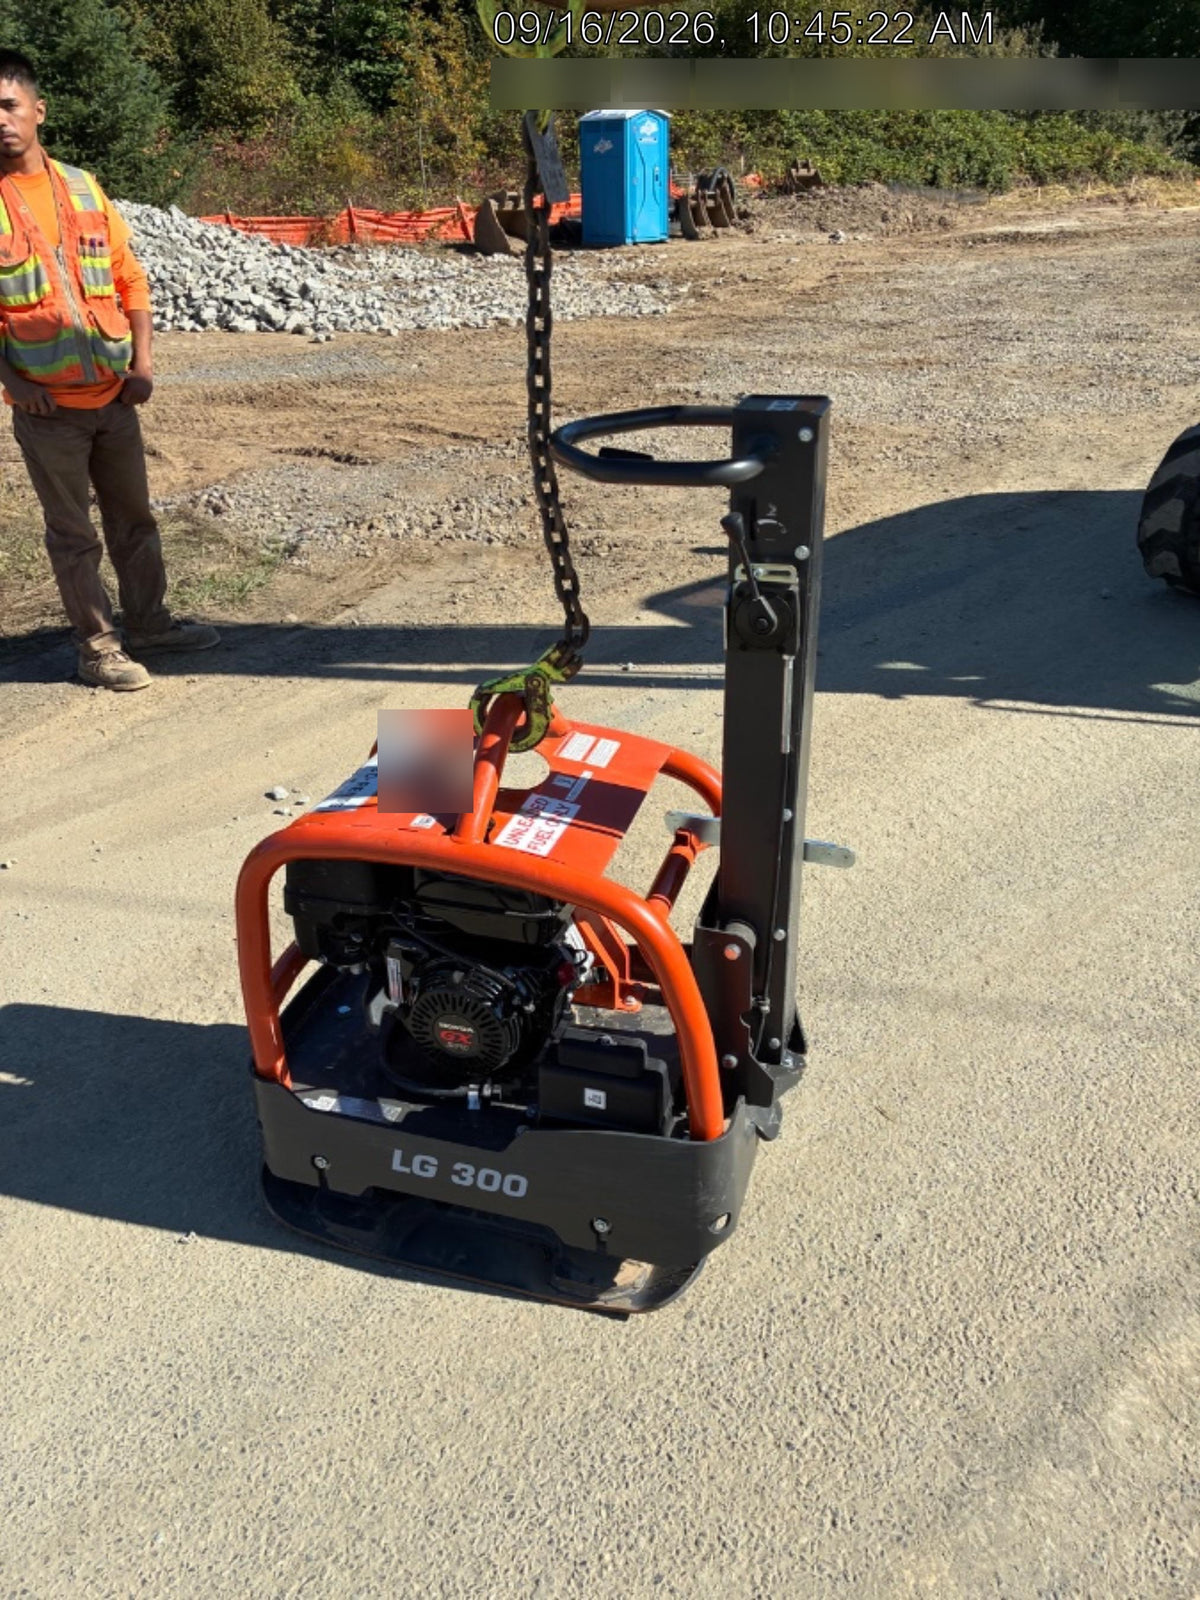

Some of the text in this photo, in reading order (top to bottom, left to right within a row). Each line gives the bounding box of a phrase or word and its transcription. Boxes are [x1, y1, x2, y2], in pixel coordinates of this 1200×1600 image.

[527, 829, 555, 853] FUEL
[440, 1030, 472, 1045] GX
[391, 1148, 529, 1198] LG 300
